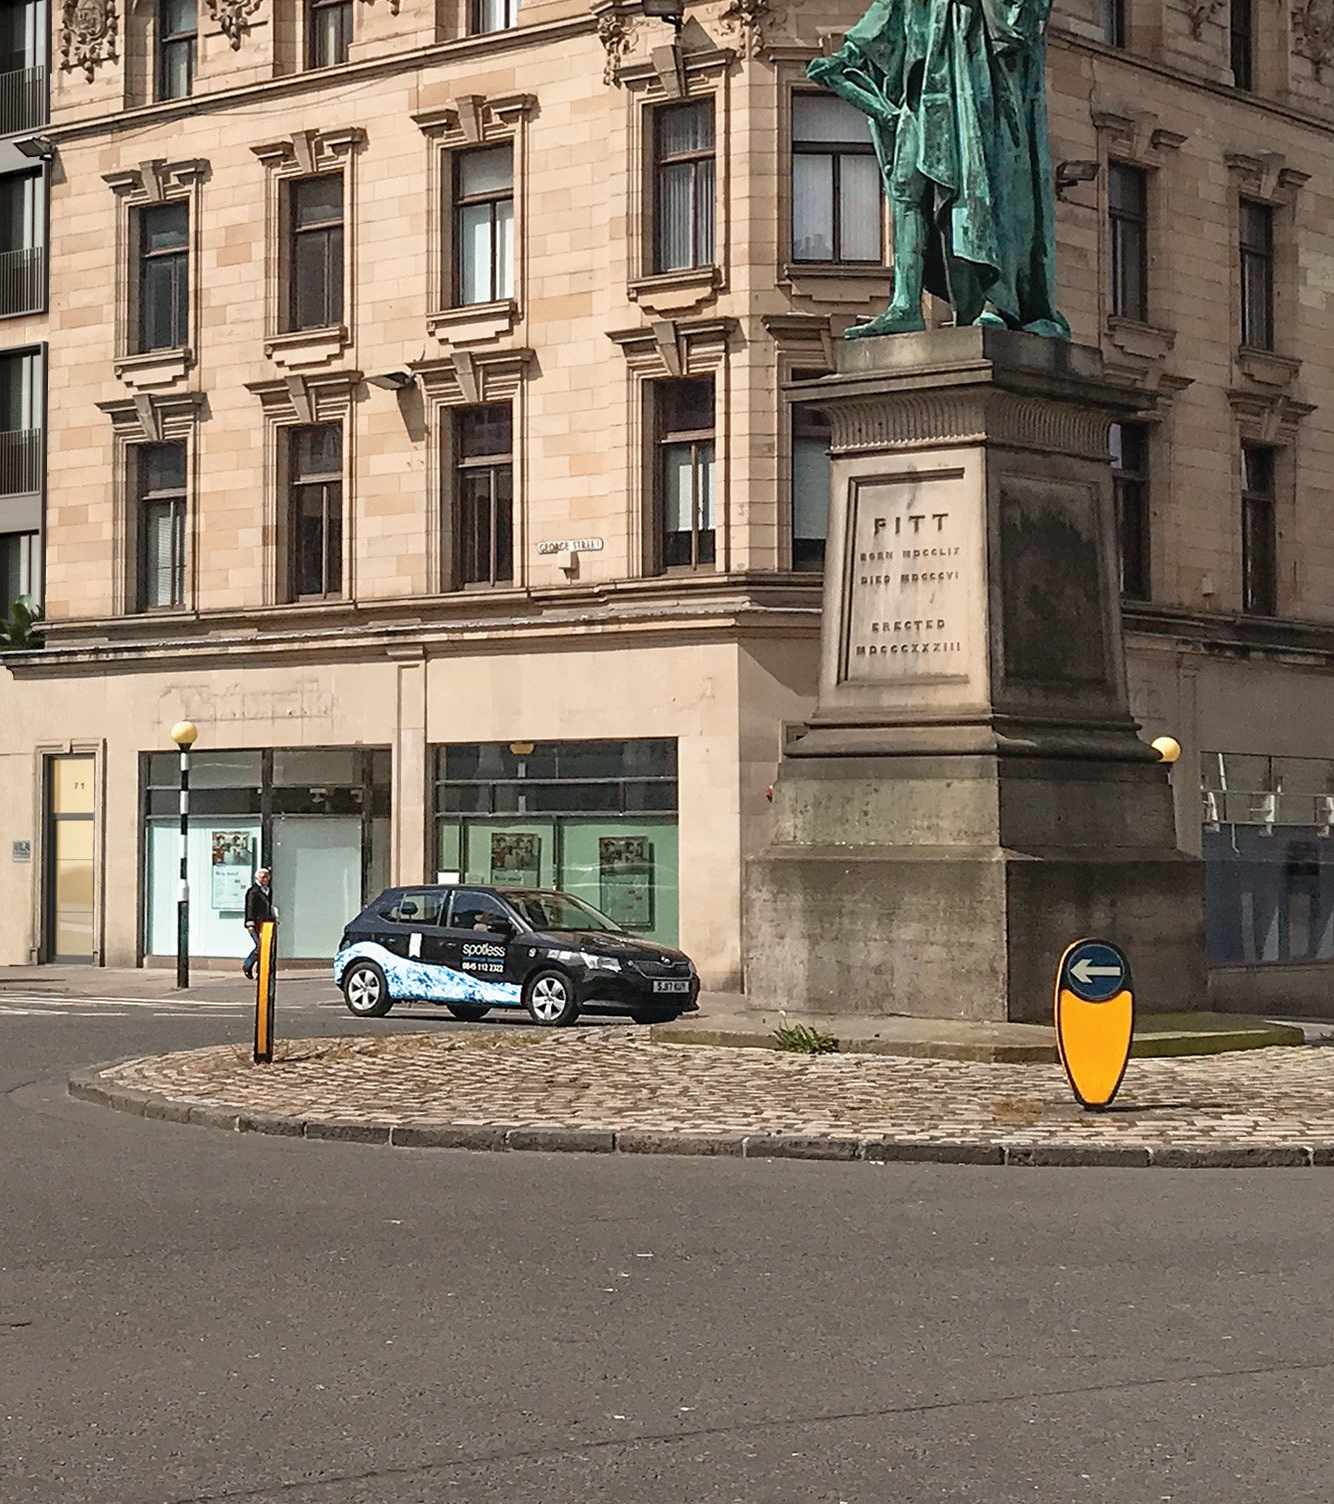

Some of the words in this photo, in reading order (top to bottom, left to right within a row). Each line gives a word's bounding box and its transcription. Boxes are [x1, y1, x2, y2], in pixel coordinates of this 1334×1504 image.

[873, 513, 949, 535] PITT
[539, 541, 570, 552] GEORGE
[573, 539, 600, 549] STREET
[860, 551, 893, 561] BORN
[860, 575, 891, 585] DIED
[900, 571, 959, 583] MDCCCVI
[872, 619, 945, 632] ERECTED
[856, 642, 961, 656] MDCCCXXXIII
[462, 943, 506, 957] spotless
